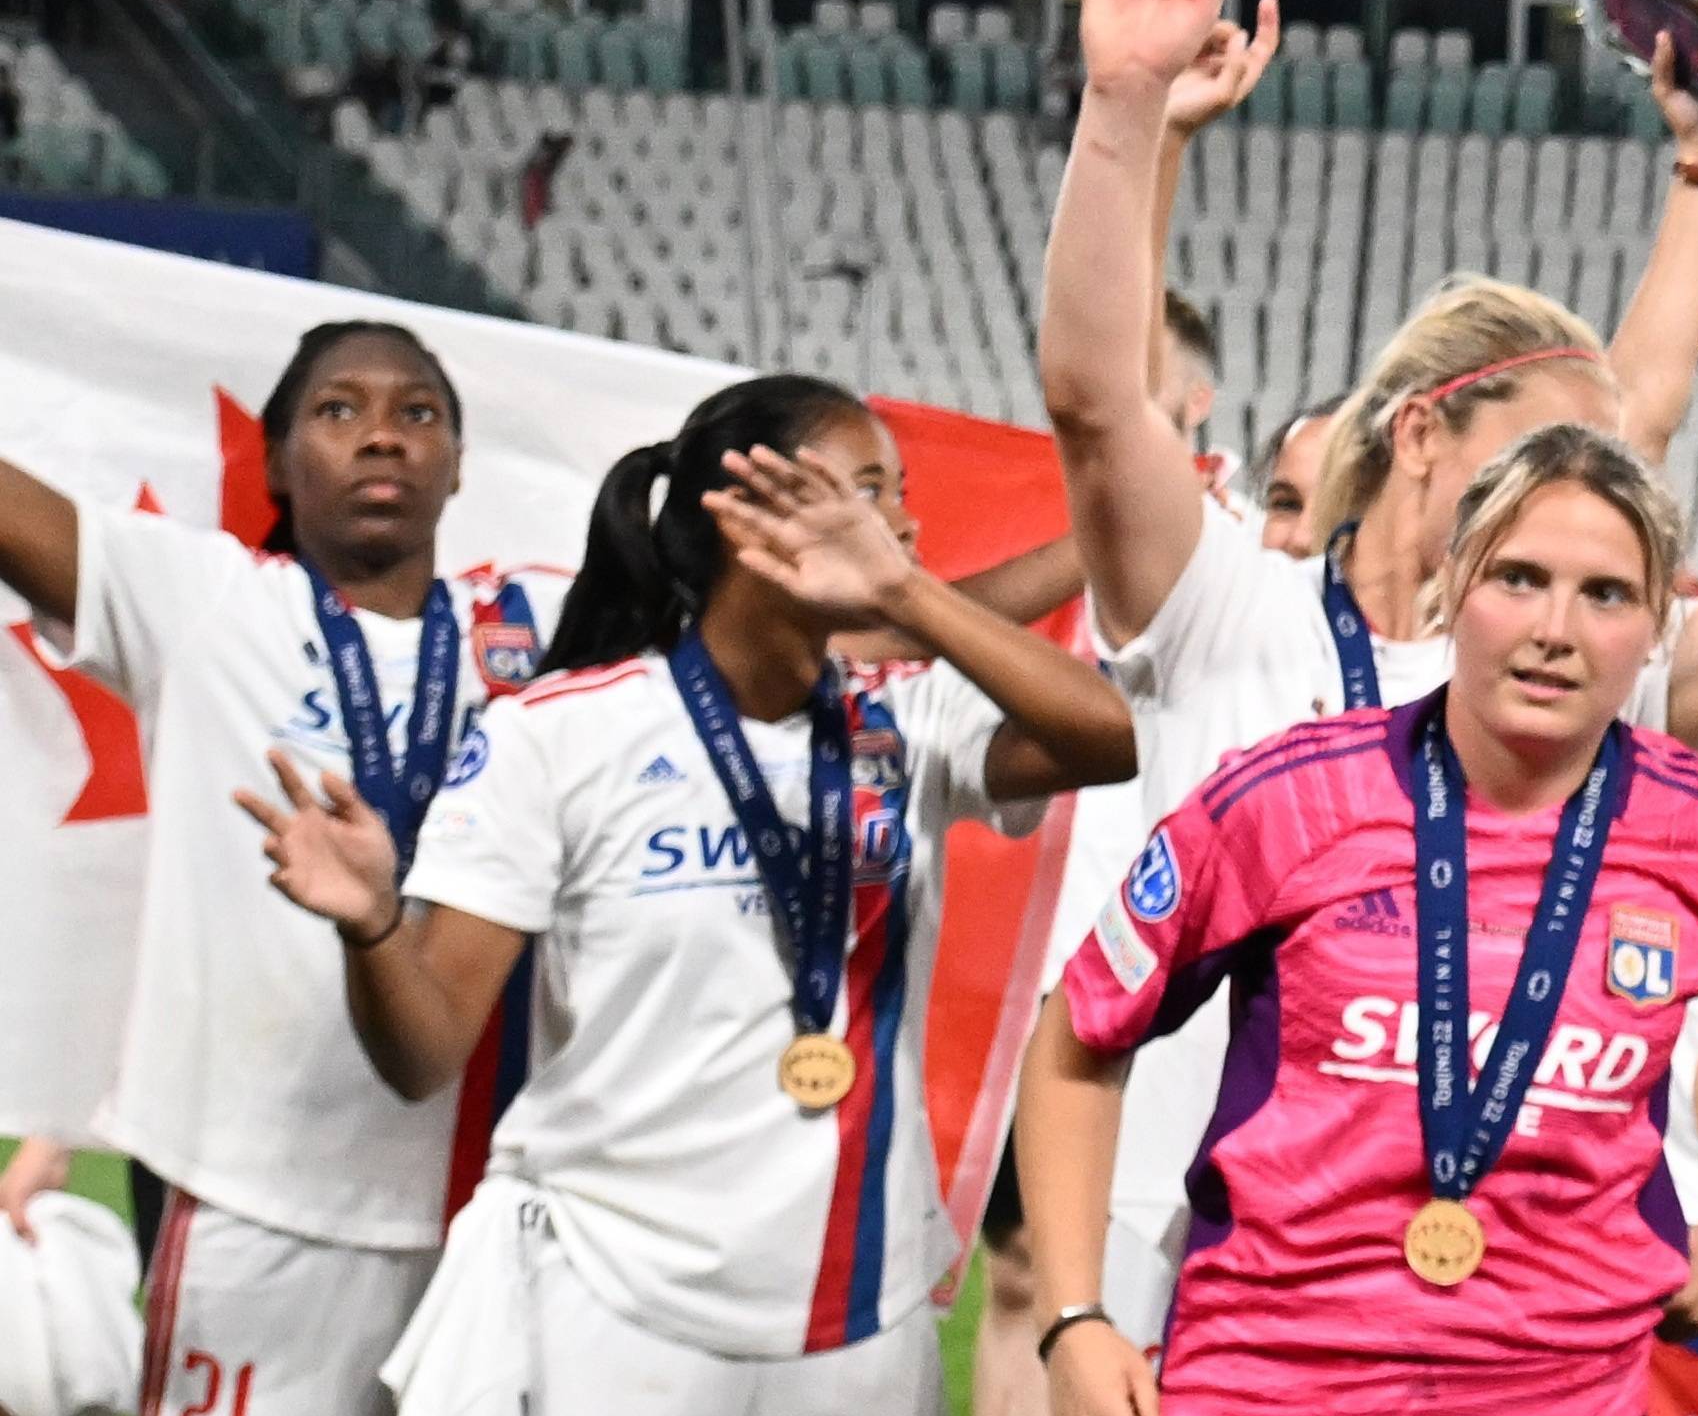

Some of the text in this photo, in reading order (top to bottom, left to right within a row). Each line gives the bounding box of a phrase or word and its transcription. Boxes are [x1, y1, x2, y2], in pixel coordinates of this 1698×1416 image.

[1571, 825, 1595, 849] 22
[1547, 853, 1585, 933] FINAL
[1435, 929, 1452, 1012] FINAL
[1331, 995, 1650, 1094] SRD
[1432, 1019, 1453, 1045] 22
[1481, 1097, 1507, 1124] 22
